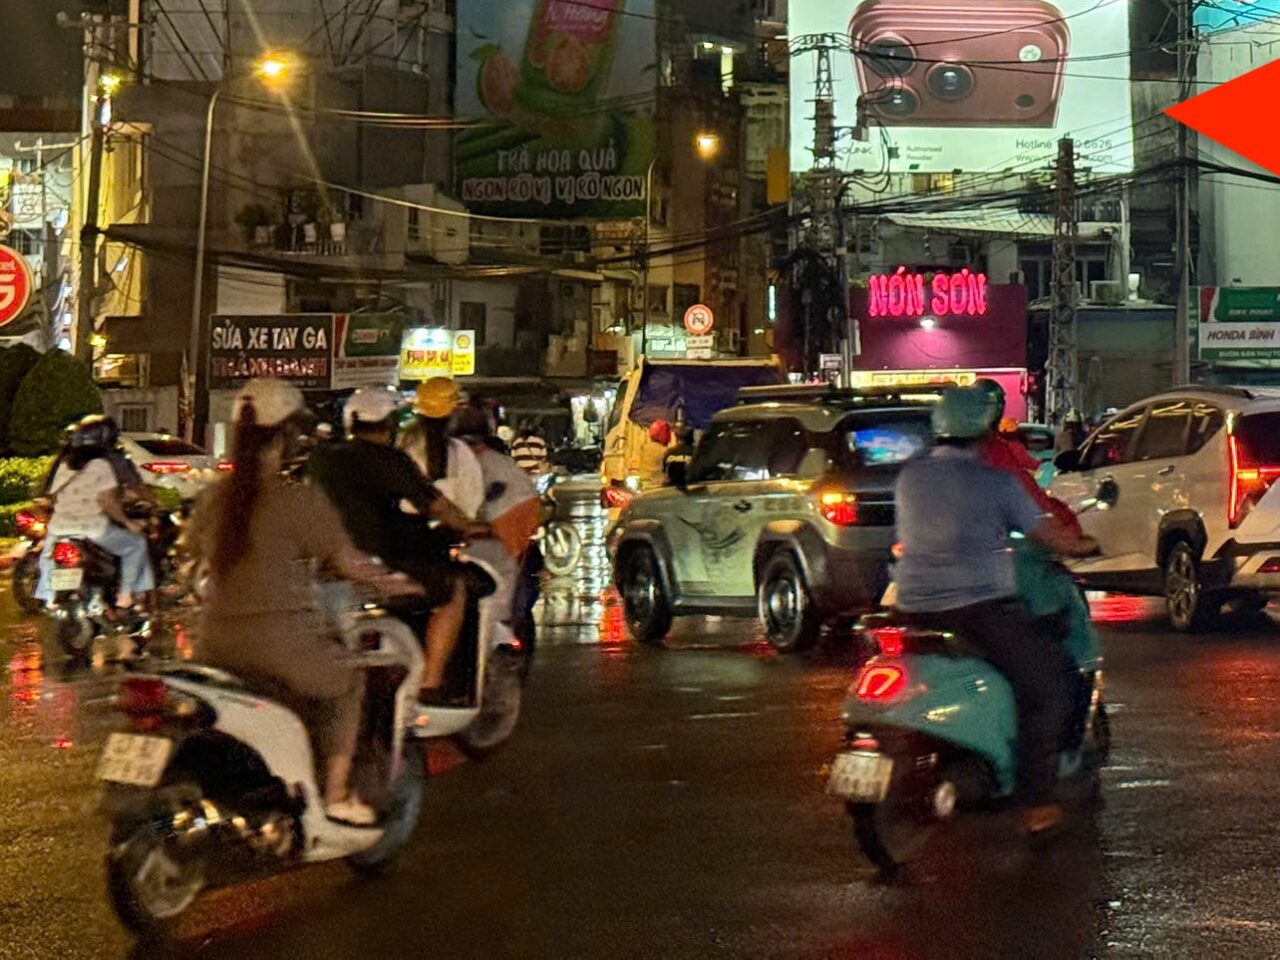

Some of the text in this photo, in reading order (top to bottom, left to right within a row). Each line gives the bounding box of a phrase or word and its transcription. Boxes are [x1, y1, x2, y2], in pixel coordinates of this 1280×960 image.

[497, 138, 616, 171] TRÀ HOA QUẢ
[1016, 139, 1053, 149] Hotline
[463, 177, 507, 201] NGON
[600, 176, 645, 201] NGON
[868, 266, 987, 317] NÓN SƠN
[212, 319, 243, 350] SỬA
[248, 327, 269, 350] XE
[272, 327, 299, 350] TAY
[303, 327, 328, 350] GA
[1207, 330, 1246, 340] HONDA
